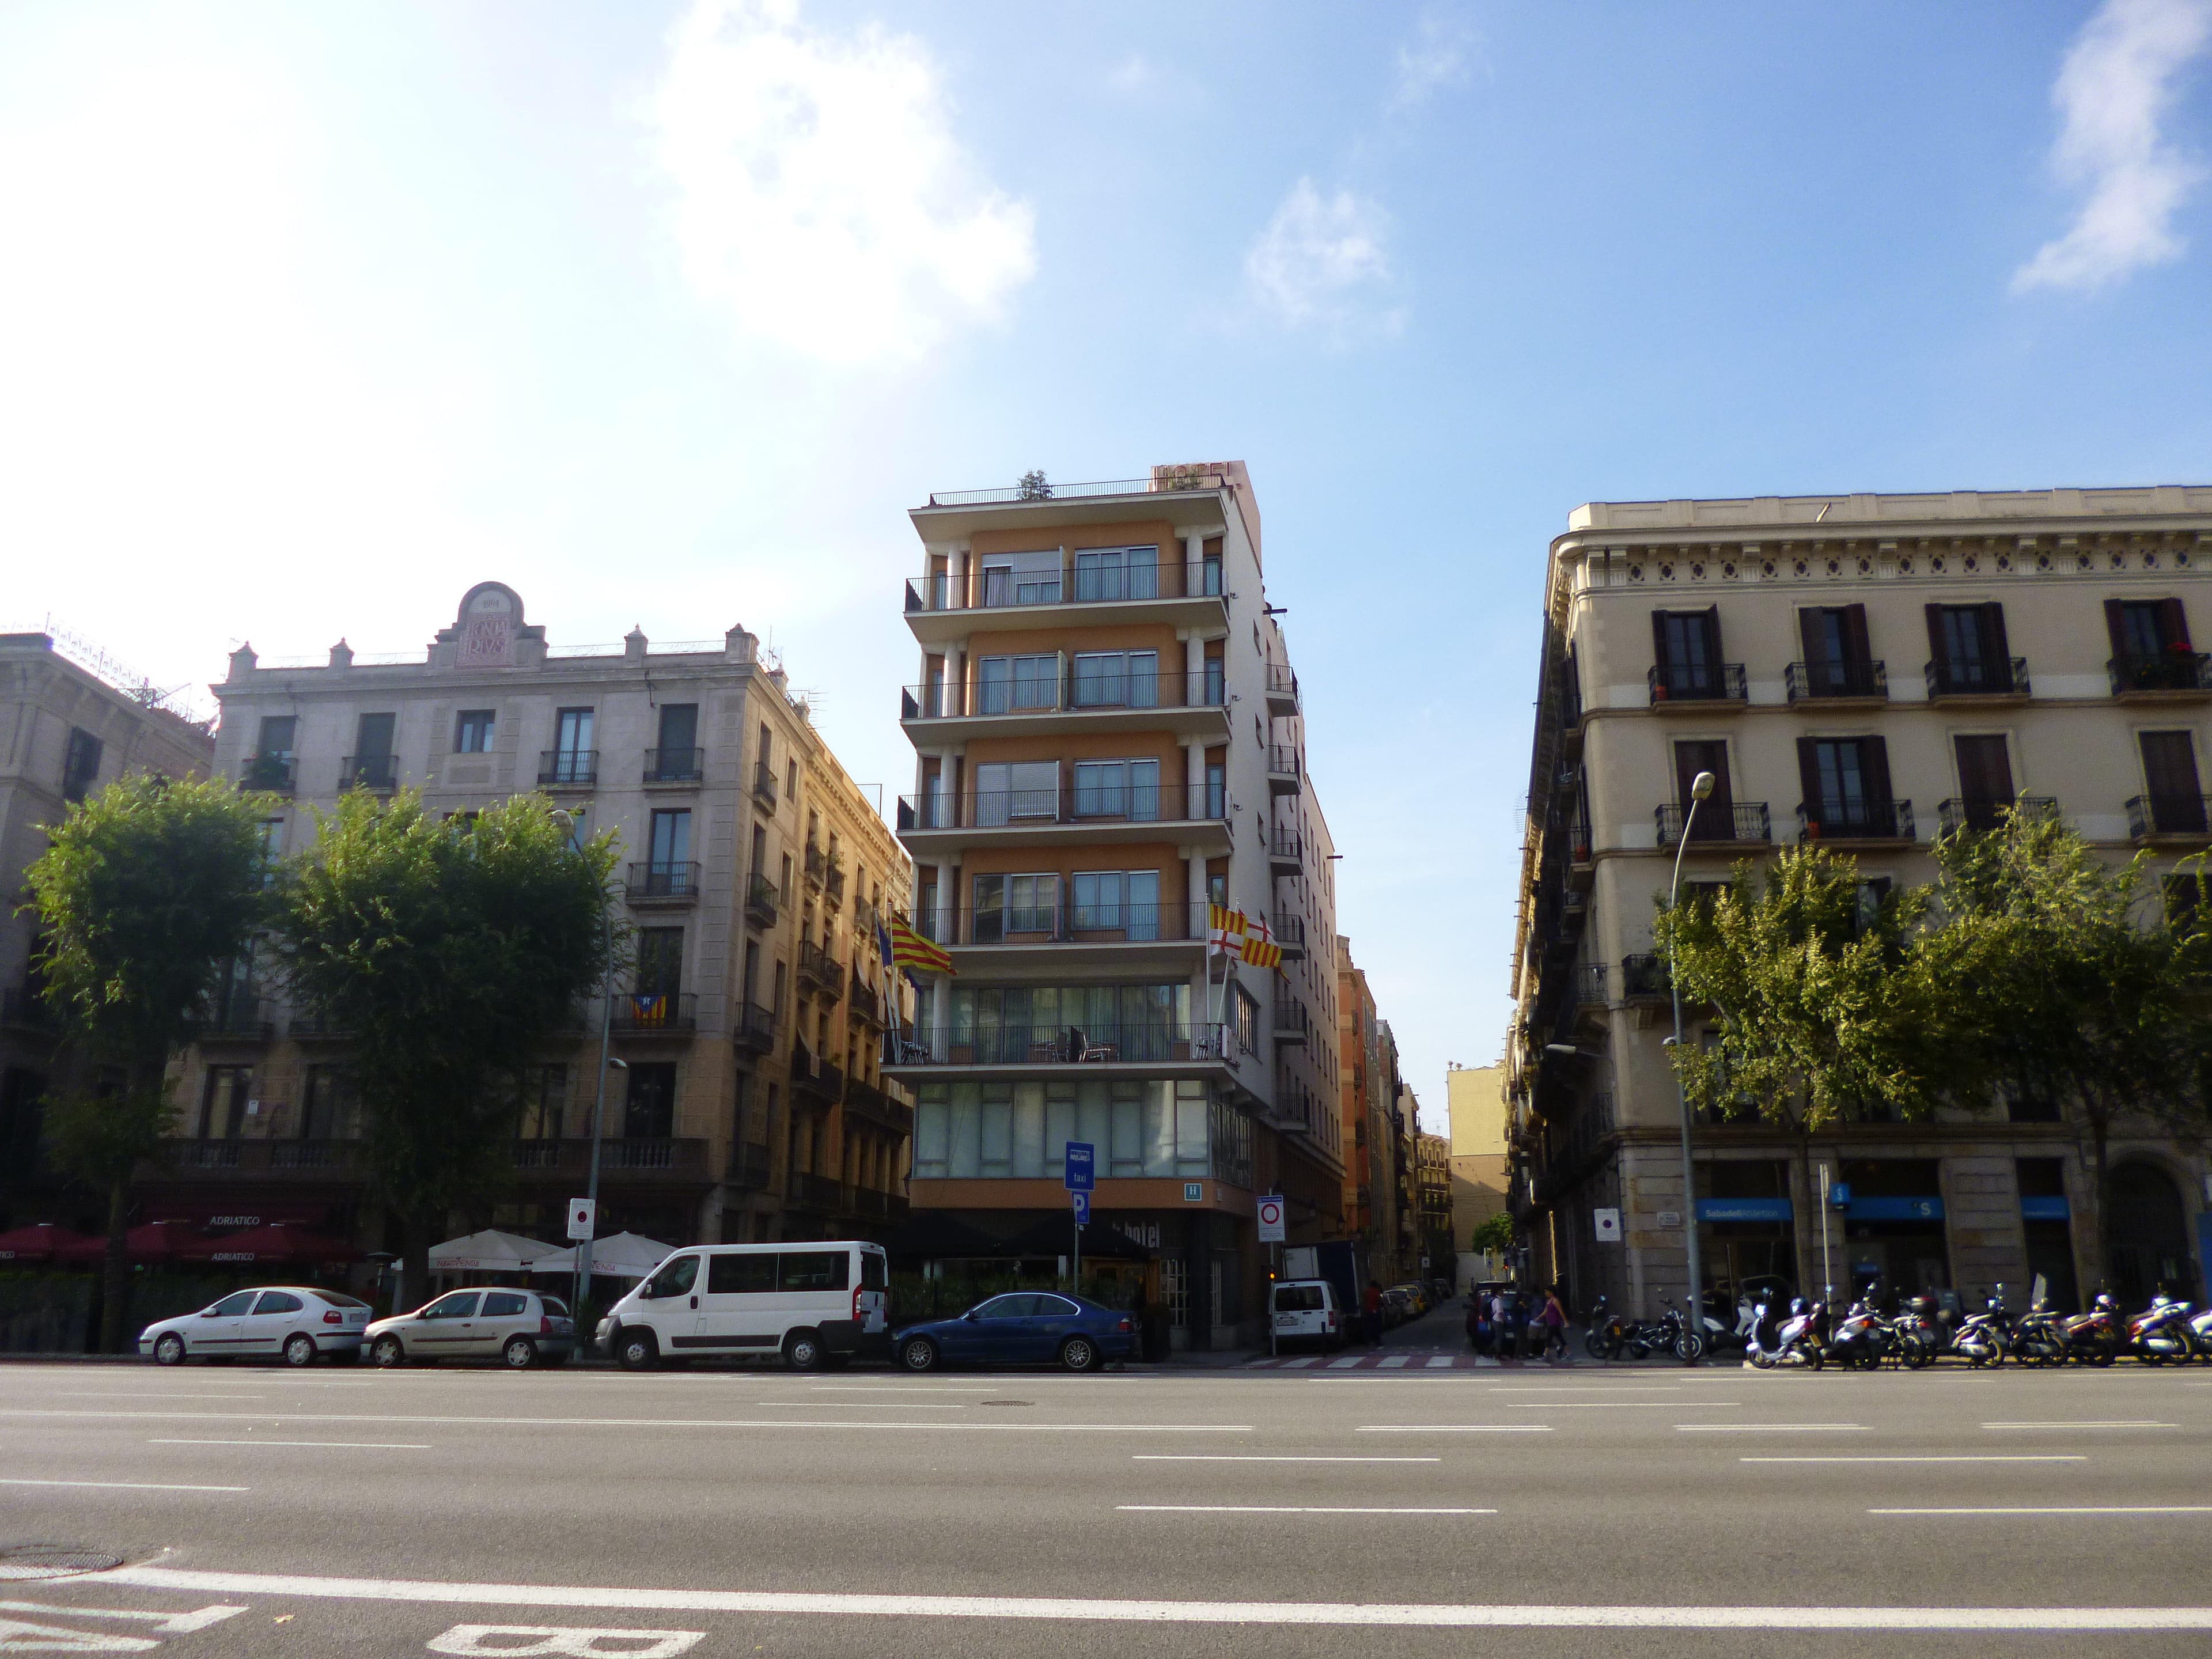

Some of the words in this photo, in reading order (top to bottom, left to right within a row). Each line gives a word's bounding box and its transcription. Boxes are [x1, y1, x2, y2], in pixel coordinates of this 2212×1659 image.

[1074, 1172, 1086, 1182] taxi
[1189, 1185, 1197, 1195] H
[1073, 1194, 1085, 1211] P
[210, 1216, 260, 1225] ADRIATICO
[211, 1252, 255, 1261] ADRIATICO
